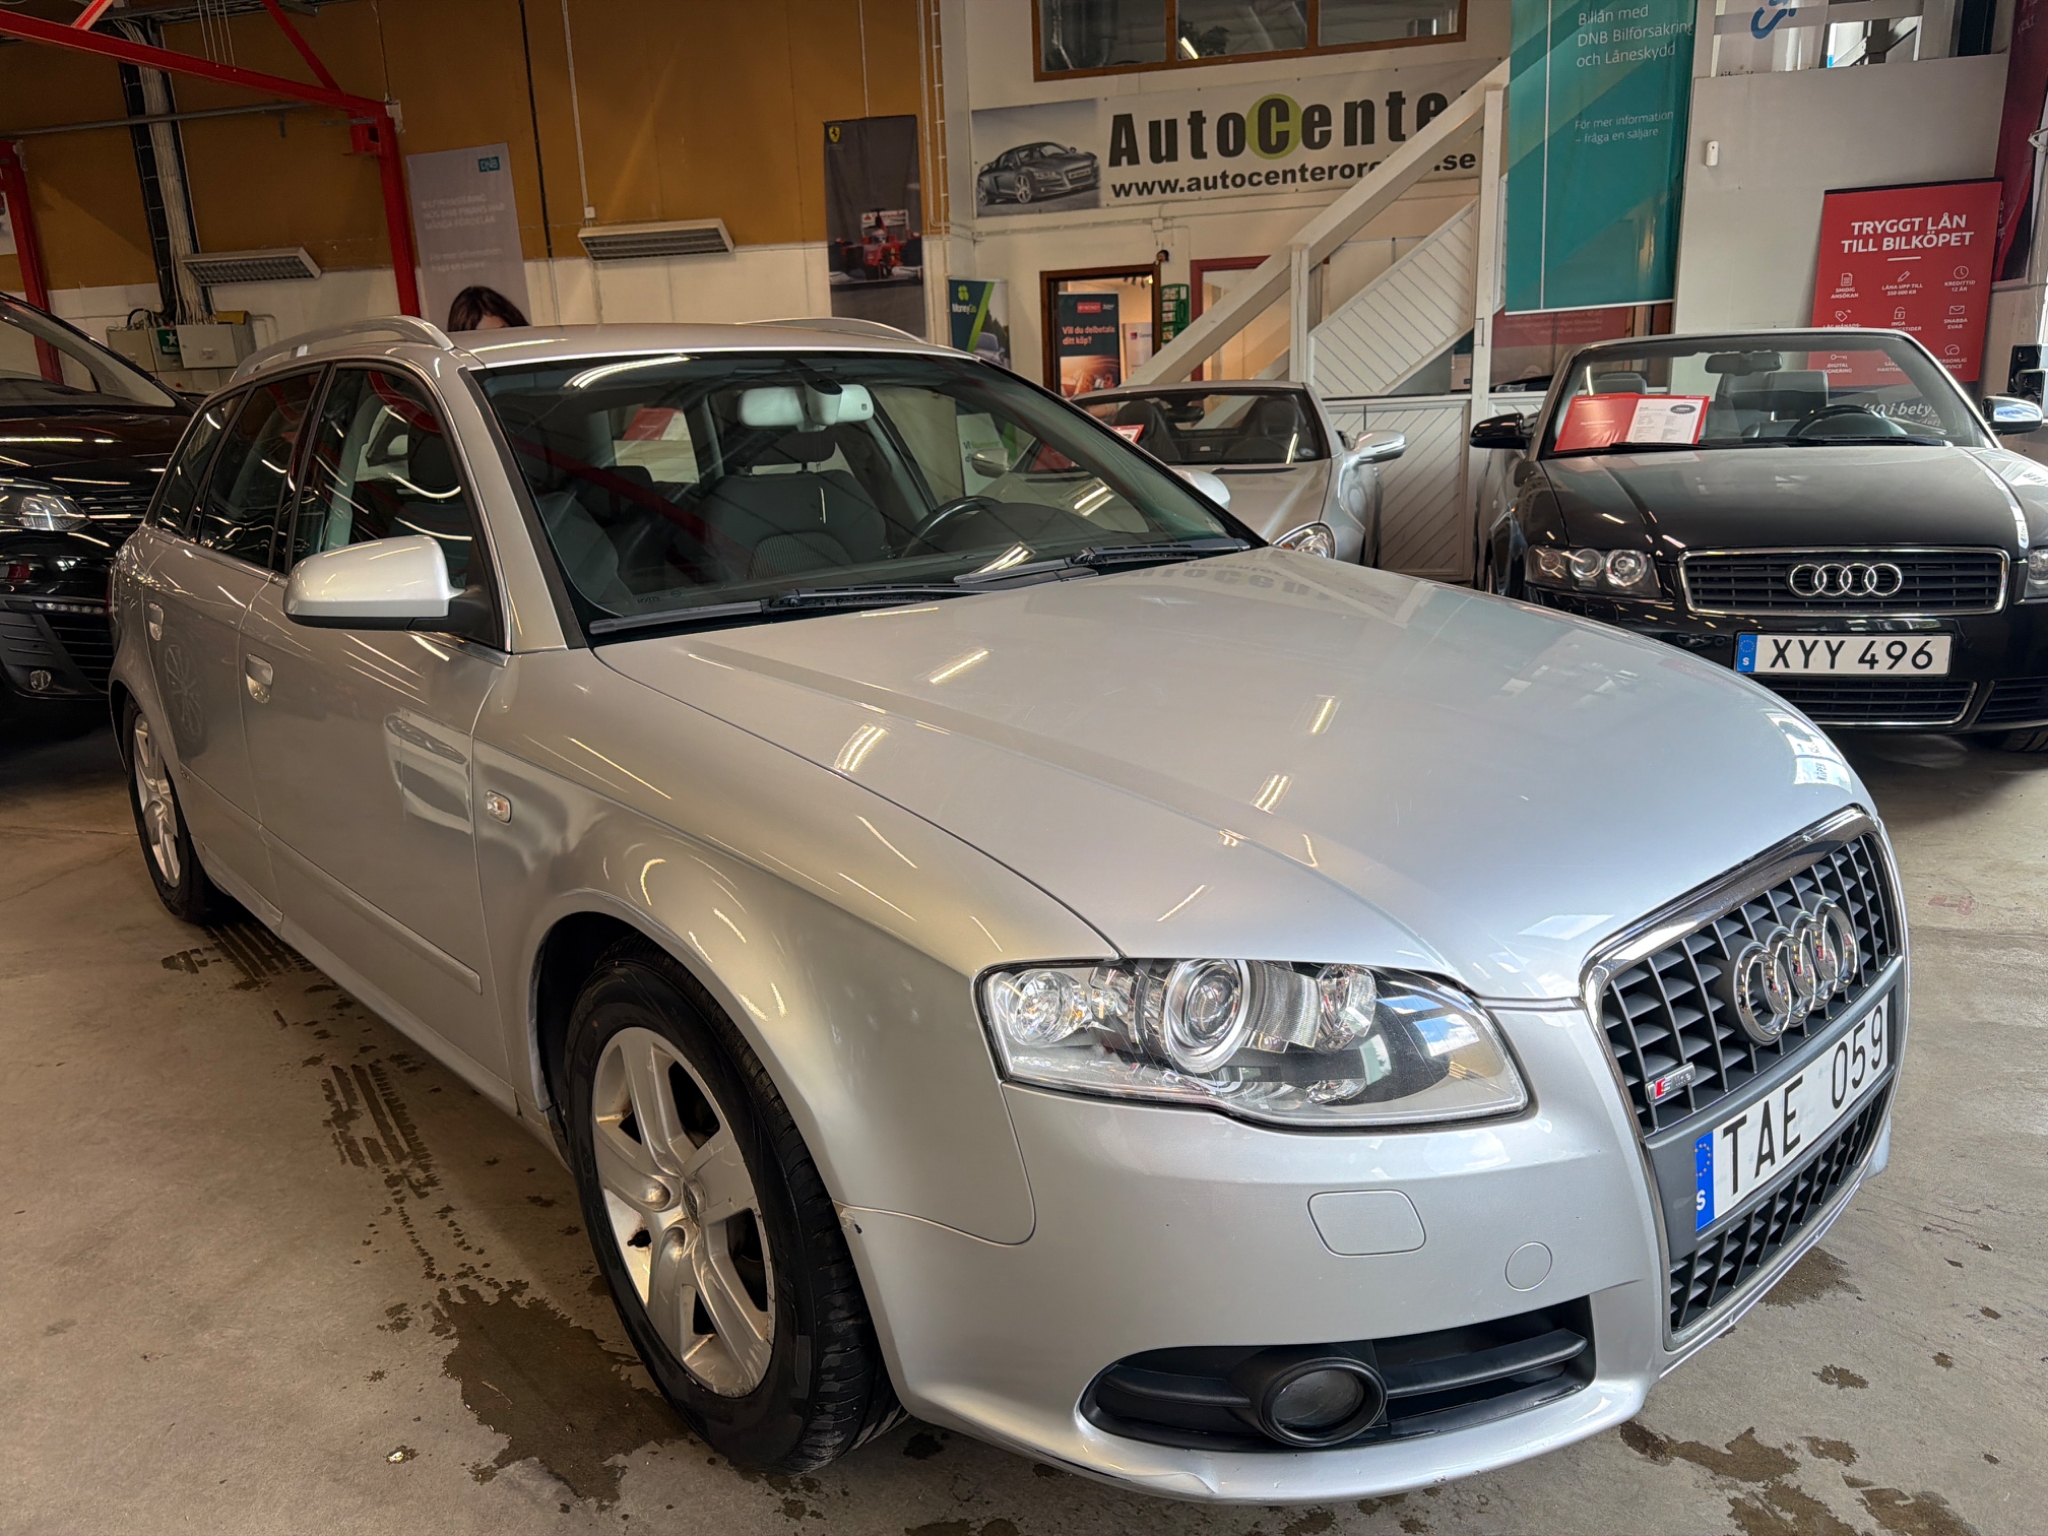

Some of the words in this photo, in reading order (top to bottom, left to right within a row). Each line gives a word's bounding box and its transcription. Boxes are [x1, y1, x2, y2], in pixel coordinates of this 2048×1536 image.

[1578, 9, 1614, 26] Billån
[1618, 4, 1649, 19] med
[1577, 31, 1608, 47] DNB
[1576, 53, 1601, 68] och
[1605, 40, 1676, 64] Låneskydd
[1108, 89, 1466, 168] AutoCente
[1575, 119, 1590, 131] För
[1594, 118, 1612, 129] mer
[1616, 111, 1674, 126] information
[1585, 132, 1609, 145] fråga
[1612, 130, 1625, 140] en
[1627, 127, 1659, 141] säljare
[480, 159, 499, 171] DNB
[1851, 217, 1924, 236] TRYGGT
[1927, 212, 1967, 231] LÅN
[1841, 240, 1878, 254] TILL
[1882, 231, 1975, 251] BILKÖPET
[1898, 402, 1938, 418] bety
[1742, 656, 1751, 667] S
[1769, 638, 1846, 670] XYY
[1857, 639, 1933, 670] 496
[1696, 1189, 1706, 1211] S
[1721, 1074, 1804, 1197] TAE
[1831, 1005, 1883, 1110] 059
